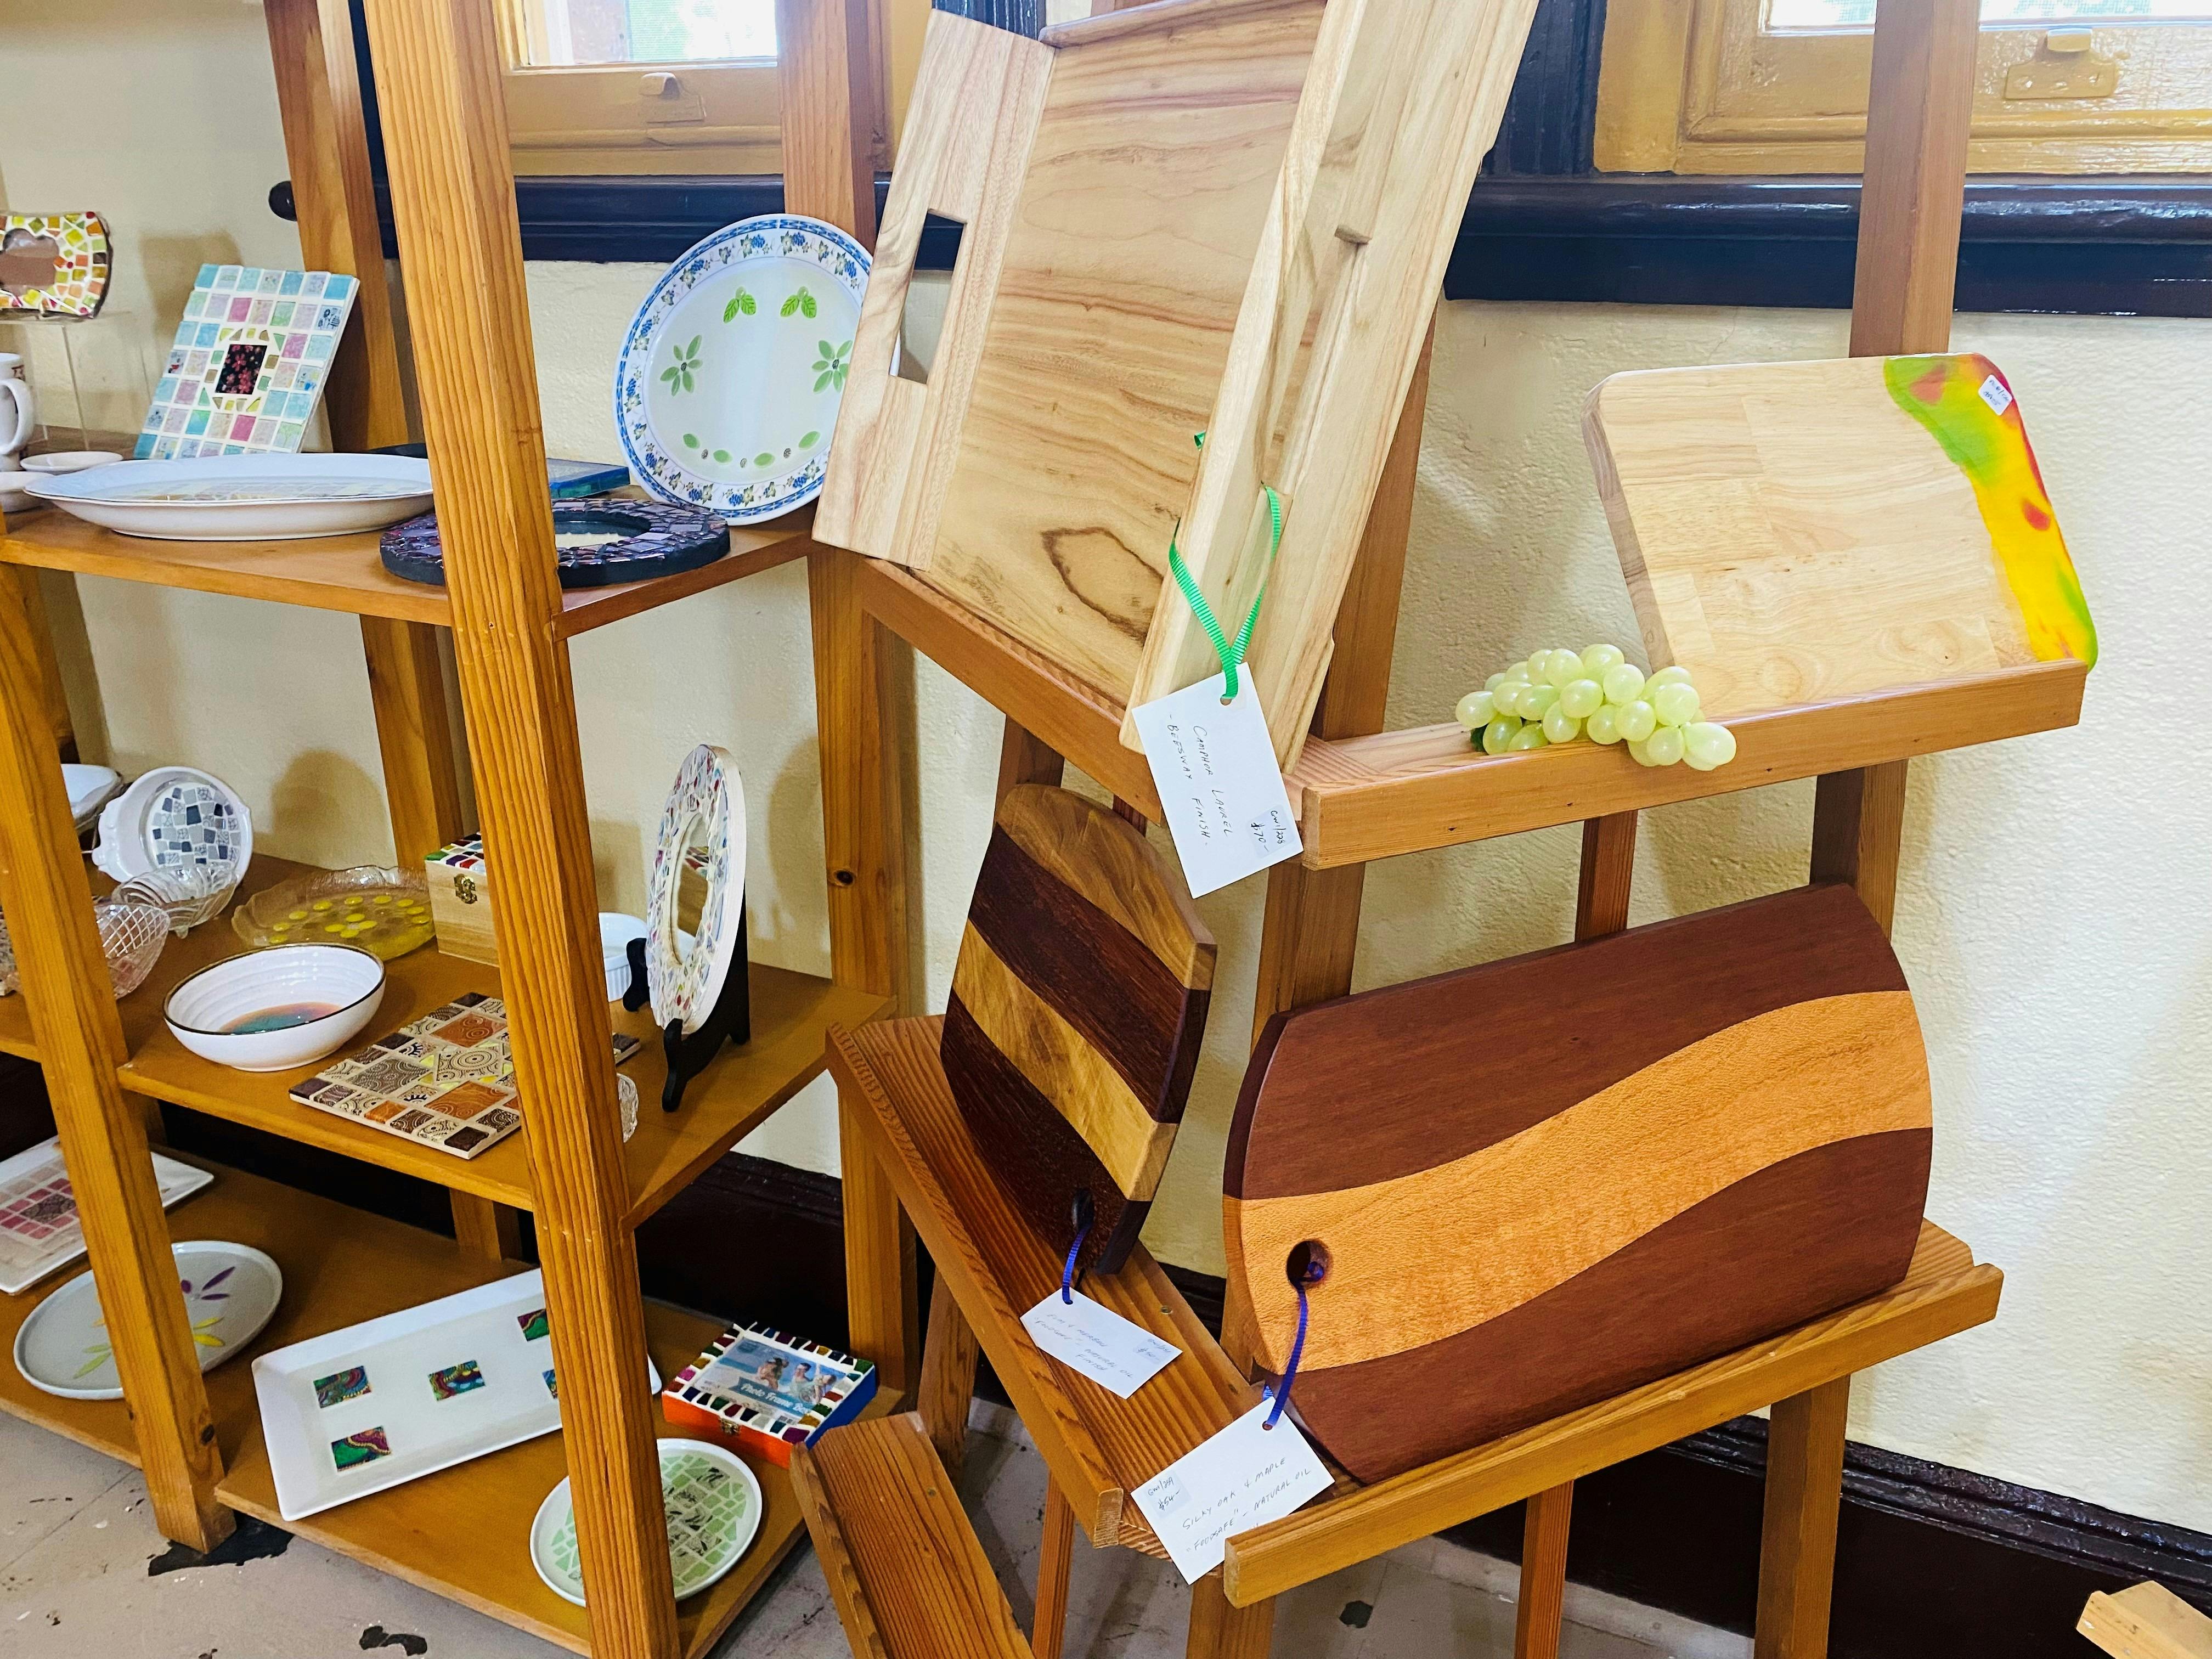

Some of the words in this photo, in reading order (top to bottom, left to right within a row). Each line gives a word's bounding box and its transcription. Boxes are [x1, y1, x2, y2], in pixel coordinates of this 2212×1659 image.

[1193, 726, 1213, 775] CAMPHOR
[1211, 789, 1233, 837] LAUREL
[1075, 1353, 1109, 1371] FINISH
[740, 1383, 765, 1397] Photo
[1183, 1506, 1211, 1530] SILKY
[1217, 1490, 1236, 1506] OAK
[1255, 1457, 1286, 1482] MAPLE
[1254, 1480, 1290, 1511] NATURAL
[1295, 1468, 1312, 1480] OIL
